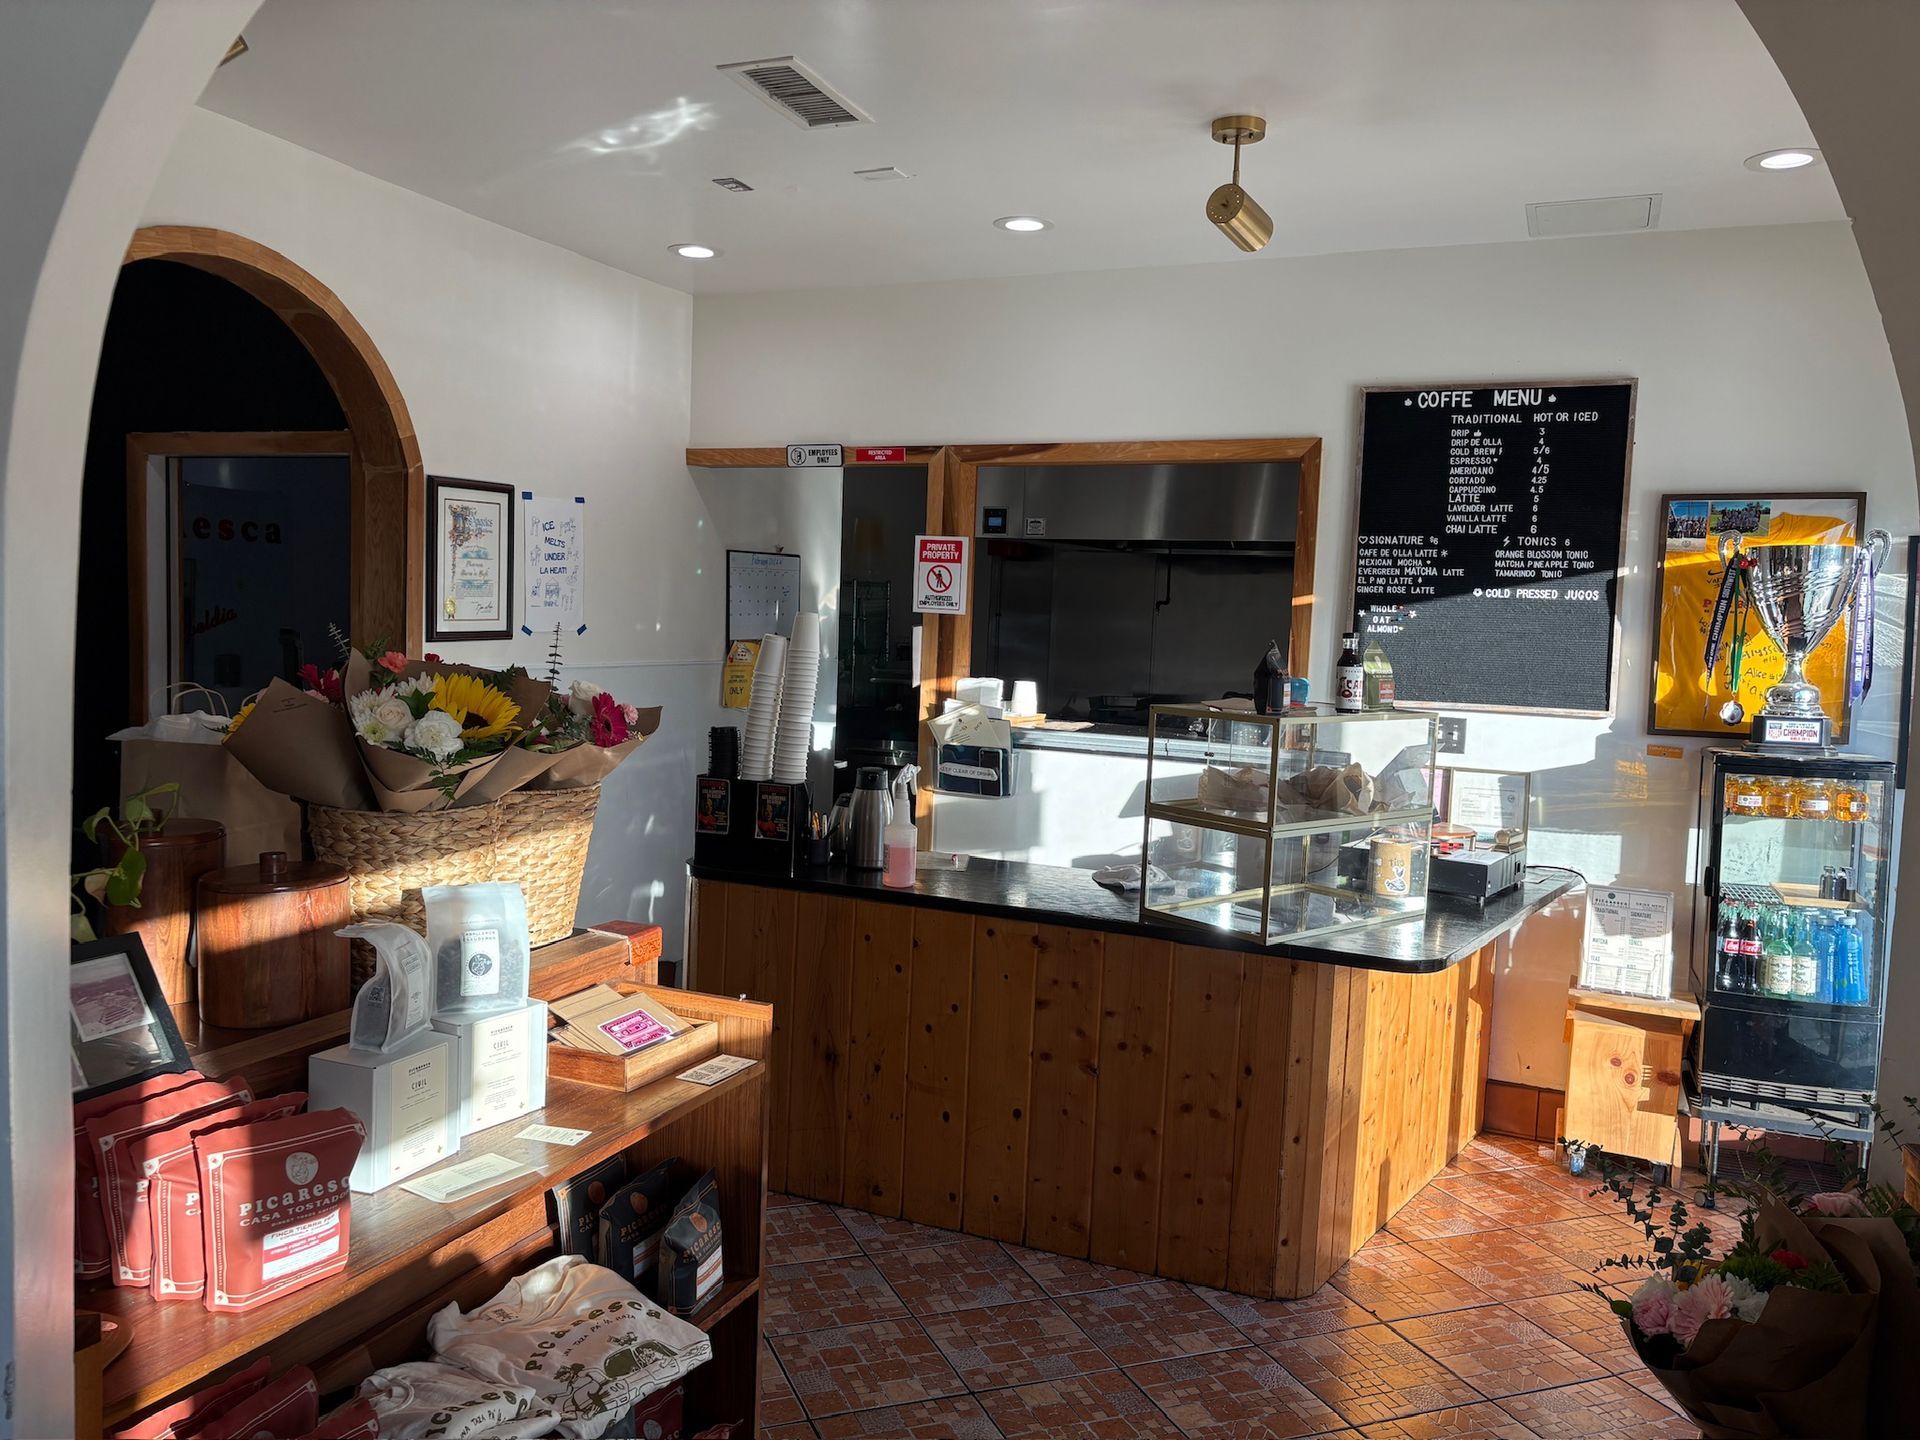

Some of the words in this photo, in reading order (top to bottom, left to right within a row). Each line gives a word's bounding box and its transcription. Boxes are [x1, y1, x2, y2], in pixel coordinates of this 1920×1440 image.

[1418, 391, 1473, 408] COFFE
[1494, 389, 1542, 407] MENU
[1451, 414, 1522, 425] TRADITIONAL
[1533, 412, 1553, 423] HOT
[1556, 412, 1569, 422] OR
[1574, 411, 1599, 422] ICED
[1451, 429, 1470, 437] DRIP
[1539, 427, 1545, 435] 3
[1451, 438, 1469, 447] DRIP
[1470, 438, 1480, 446] DE
[1482, 438, 1502, 446] OLLA
[1538, 437, 1544, 445] 4
[808, 448, 838, 456] EMPLOYEES
[1450, 447, 1470, 456] COLD
[1473, 447, 1496, 456] BREW
[1533, 445, 1550, 455] 5/6
[816, 456, 830, 464] ONLY
[1450, 456, 1492, 465] ESPRESSO
[1536, 456, 1542, 464] 4
[1449, 466, 1494, 475] AMERICANO
[1531, 464, 1550, 475] 4/5
[1448, 476, 1486, 484] CORTADO
[1448, 485, 1497, 494] CAPPUCCINO
[1530, 485, 1544, 494] 4.5
[1448, 494, 1480, 503] LATTE
[1533, 495, 1540, 503] 5
[1447, 504, 1486, 512] LAVENDER
[1490, 504, 1514, 512] LATTE
[1532, 504, 1538, 512] 6
[1446, 514, 1480, 522] VANILLA
[1481, 514, 1507, 522] LATTE
[1531, 514, 1538, 523] 6
[542, 521, 555, 532] ICE
[1445, 525, 1466, 534] CHAI
[1468, 525, 1498, 534] LATTE
[1530, 525, 1538, 534] 6
[544, 536, 566, 549] MELTS
[1369, 535, 1424, 545] SIGNATURE
[1517, 536, 1557, 546] TONICS
[1564, 538, 1571, 546] 6
[926, 543, 956, 551] PRIVATE
[544, 552, 566, 561] UNDER
[922, 550, 959, 560] PROPERTY
[1359, 549, 1378, 557] CAFE
[1380, 548, 1390, 557] DE
[1392, 549, 1413, 557] OLLA
[1414, 549, 1438, 557] LATTE
[1495, 550, 1525, 559] ORANGE
[1527, 550, 1562, 559] BLOSSOM
[1566, 550, 1589, 560] TONIC
[1358, 558, 1392, 566] MEXICAN
[1397, 558, 1423, 567] MOCHA
[1495, 560, 1525, 568] MATCHA
[1527, 560, 1569, 569] PINEAPPLE
[1572, 560, 1595, 569] TONIC
[1358, 567, 1400, 575] EVERGREEN
[1404, 567, 1438, 576] MATCHA
[1443, 568, 1465, 576] LATTE
[1495, 569, 1536, 578] TAMARINDO
[1541, 570, 1562, 579] TONIC
[1357, 576, 1367, 584] EL
[1389, 577, 1413, 585] LATTE
[1356, 586, 1384, 594] GINGER
[1386, 586, 1407, 594] ROSE
[1411, 586, 1435, 595] LATTE
[1485, 588, 1511, 598] COLD
[1516, 588, 1558, 599] PRESSED
[1564, 589, 1600, 601] JUGOS
[1370, 605, 1398, 613] WHOLE
[1372, 615, 1391, 624] OAT
[1712, 600, 1728, 641] CHAMPION
[1366, 624, 1399, 634] ALMOND
[1783, 729, 1817, 738] CHAMPION
[411, 1078, 427, 1090] CIVIL
[239, 1212, 281, 1227] CASA
